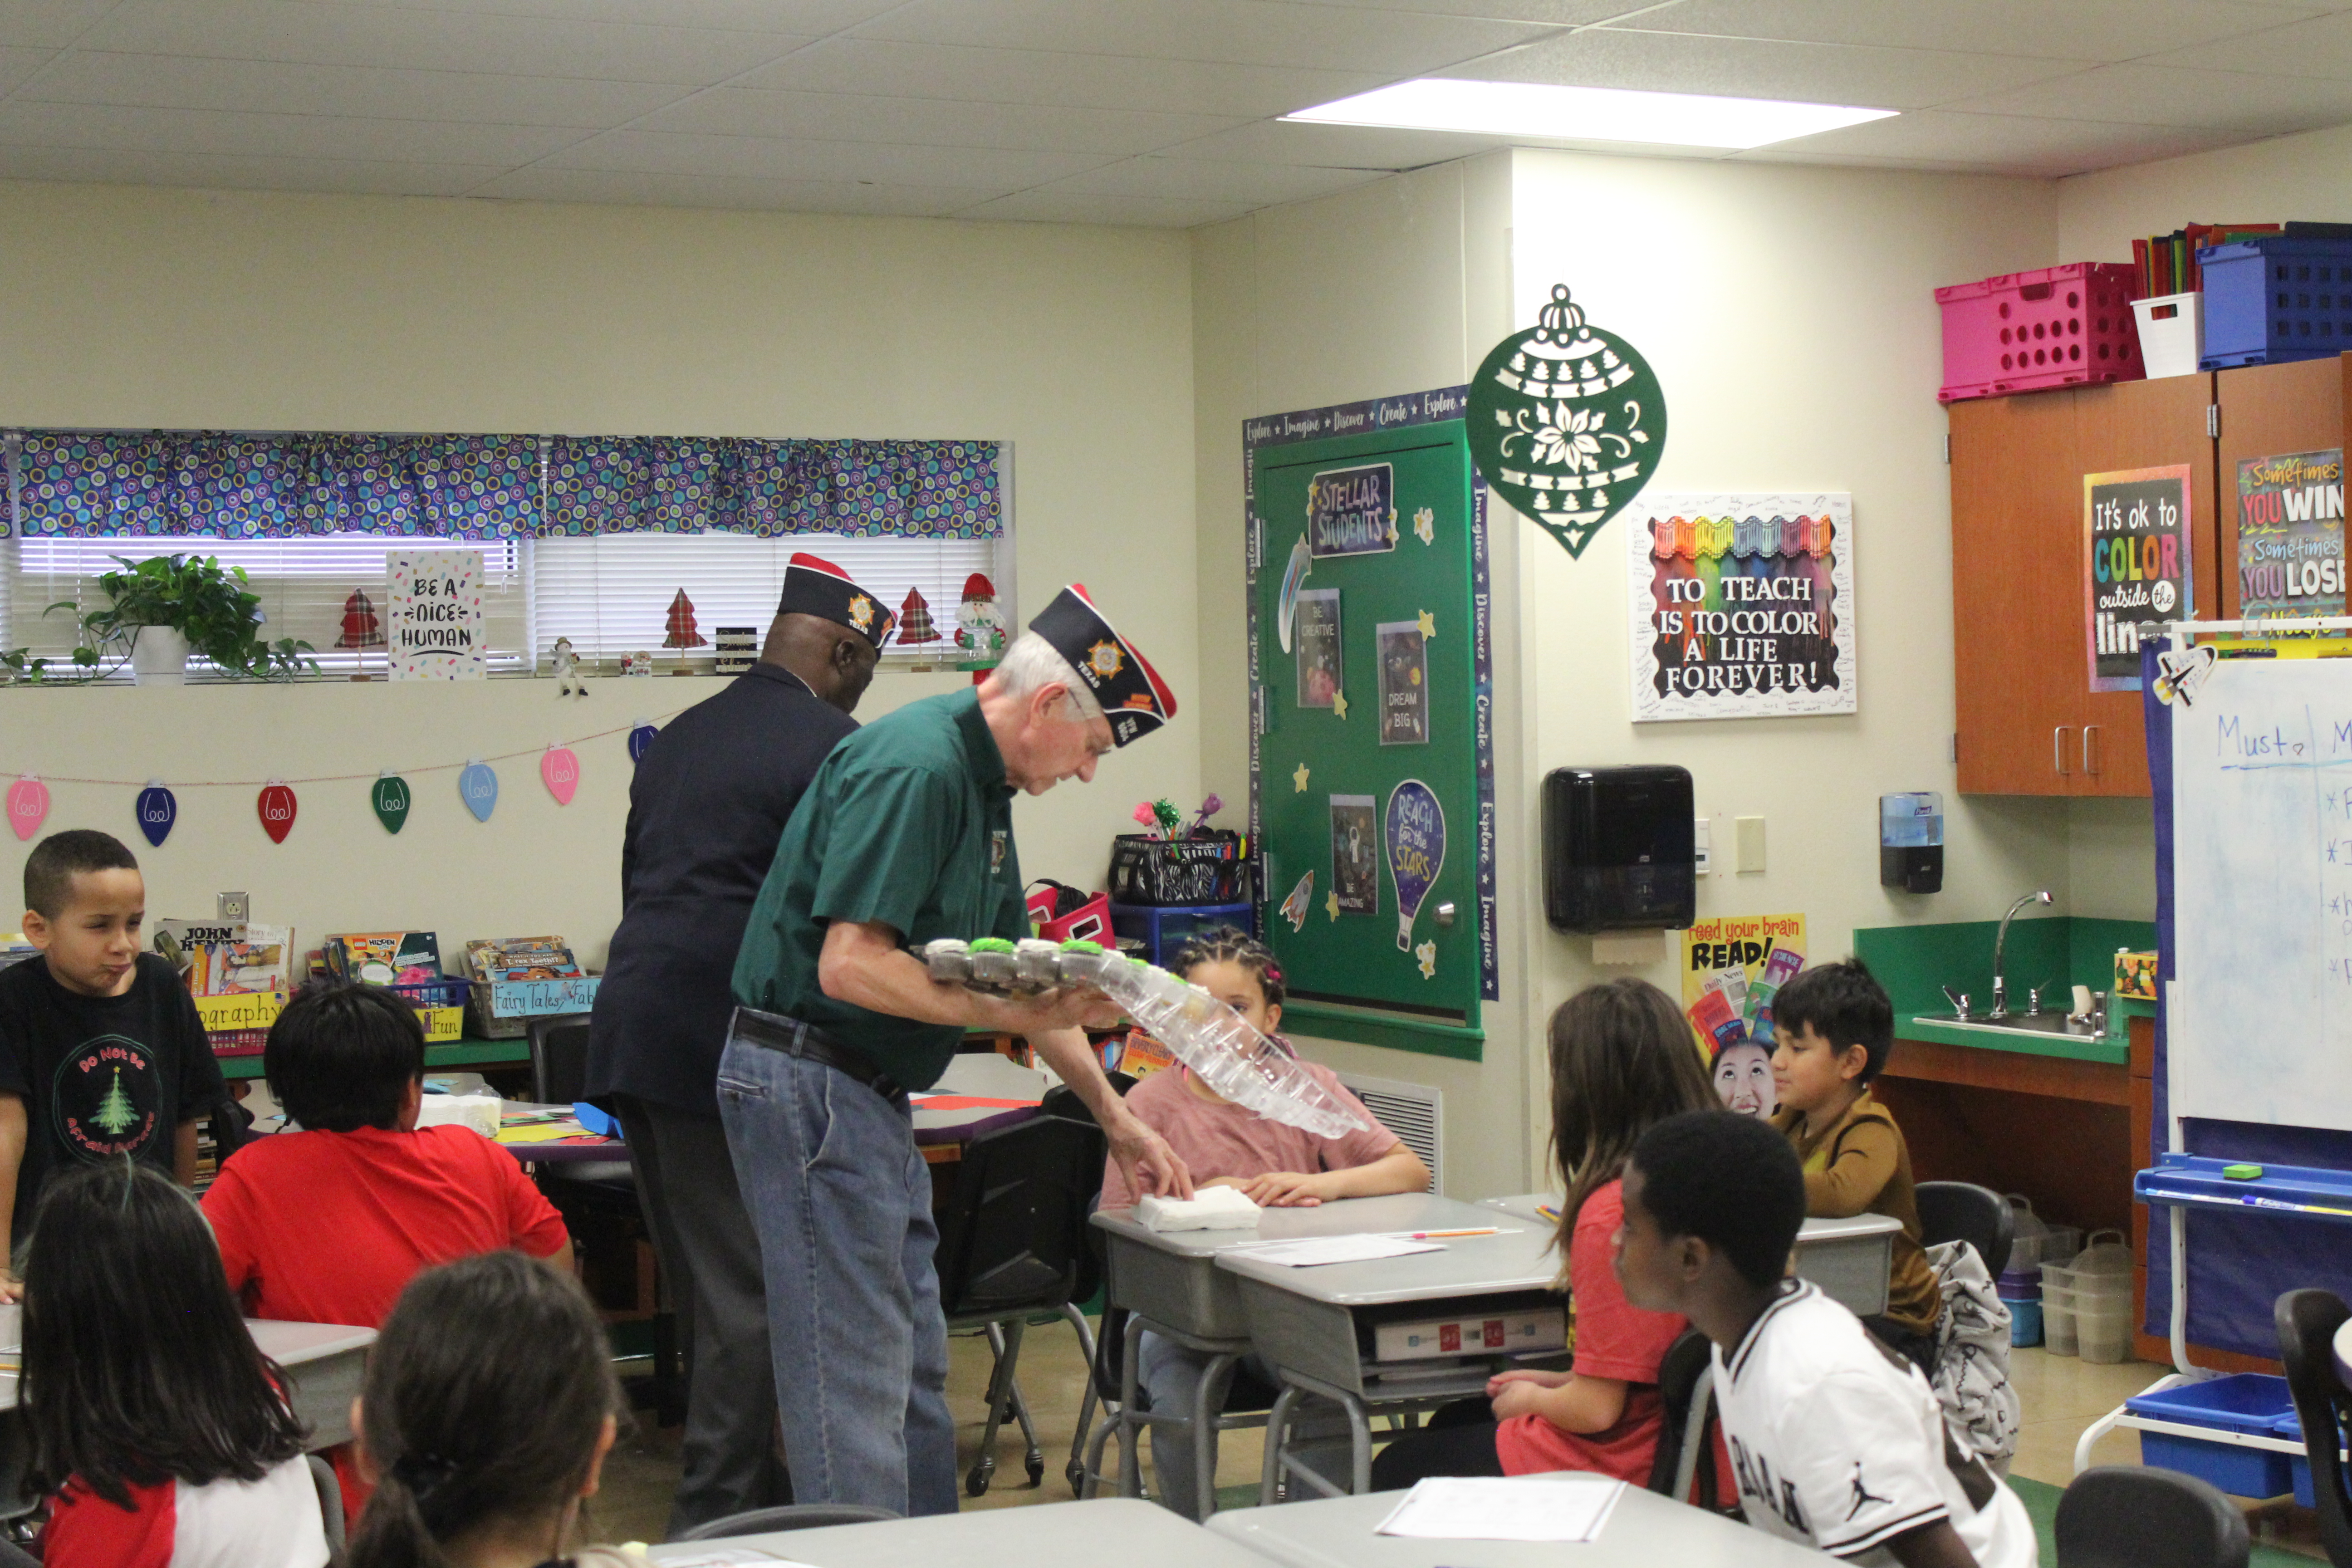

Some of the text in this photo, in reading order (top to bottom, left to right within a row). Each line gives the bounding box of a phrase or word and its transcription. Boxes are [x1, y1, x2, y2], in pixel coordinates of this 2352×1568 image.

[1247, 393, 1456, 444] Explore Imagine Discover Create Explore
[2253, 462, 2339, 487] Sometimes
[1322, 475, 1380, 511] STELLAR
[2243, 484, 2344, 525] YOU WIN
[1318, 507, 1383, 549] STUDENTS
[2096, 497, 2176, 531] It's ok to
[1247, 529, 1256, 585] Explore
[2095, 534, 2180, 583] COLOR
[2255, 537, 2339, 563] Sometimes
[414, 578, 457, 597] BE A
[1666, 578, 1706, 603] TO
[1720, 576, 1812, 602] TEACH
[2244, 565, 2283, 598] YOU
[2099, 583, 2174, 609] outside the
[1313, 606, 1322, 617] BE
[1659, 610, 1684, 635] IS
[1691, 610, 1728, 635] TO
[1731, 610, 1819, 635] COLOR
[402, 628, 471, 647] HUMAN
[848, 618, 868, 635] TEXAS
[1301, 624, 1335, 637] CREATIVE
[2096, 612, 2178, 655] lin
[1250, 632, 1259, 681] Create
[1684, 637, 1778, 662] A LIFE
[1078, 660, 1101, 688] TEXAS
[1666, 661, 1817, 691] FOREVER!
[1388, 693, 1417, 706] DREAM
[1394, 713, 1411, 727] BIG
[1471, 486, 1494, 970] Imagine Discover Create Explore Imagine
[1251, 710, 1260, 772] Discover
[2217, 714, 2288, 757] Must
[1398, 794, 1433, 833] REACH
[1250, 799, 1261, 867] Imagine
[1398, 823, 1427, 850] for the
[1396, 846, 1430, 882] STARS
[1346, 883, 1355, 893] BE
[1338, 897, 1364, 908] AMAZING
[1254, 895, 1264, 942] xplore
[1726, 921, 1759, 945] your
[1763, 917, 1799, 937] brain
[186, 927, 233, 940] JOHN
[1691, 937, 1773, 971] READ!
[1773, 951, 1800, 968] SCIENCE
[1704, 970, 1743, 992] Daily News
[495, 985, 526, 1014] Fairy
[433, 1010, 457, 1034] Fun
